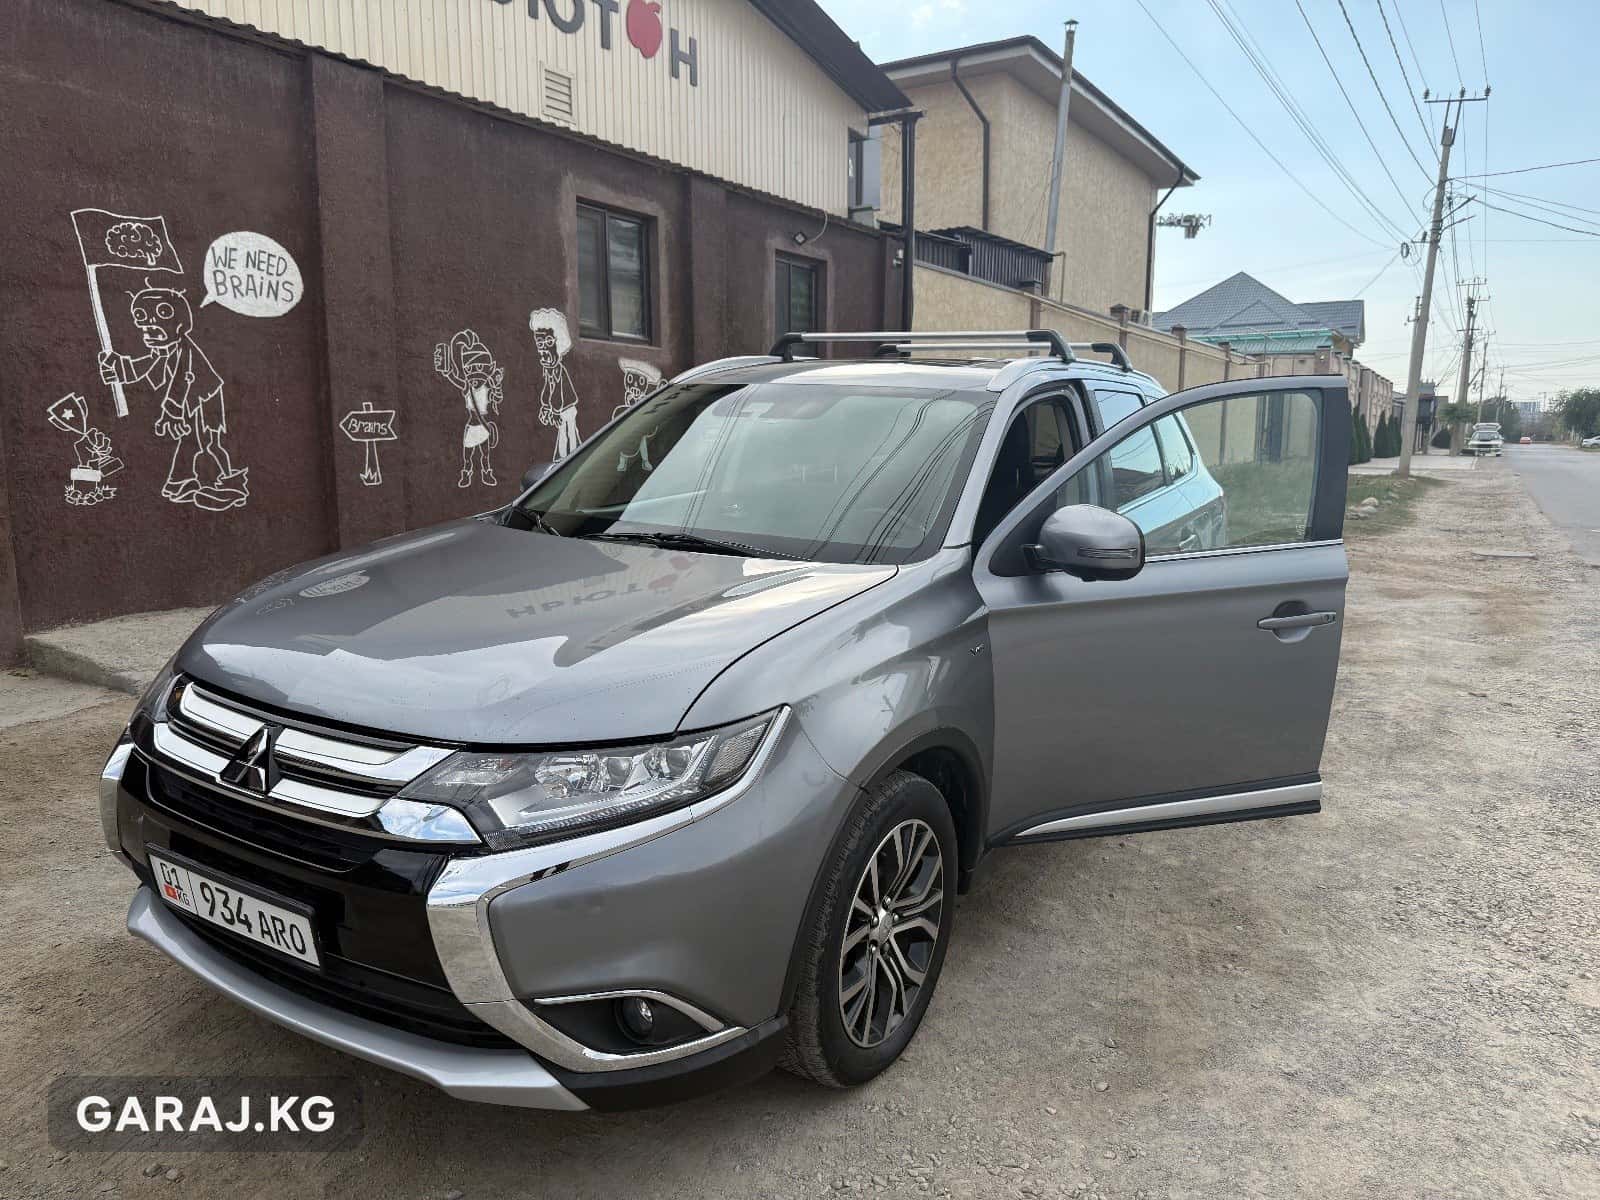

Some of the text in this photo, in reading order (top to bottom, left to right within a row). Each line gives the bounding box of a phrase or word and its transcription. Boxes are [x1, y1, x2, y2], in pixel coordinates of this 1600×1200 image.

[211, 246, 287, 277] WE NEED
[348, 418, 387, 434] Brains
[160, 863, 306, 955] 01 934 ARO
[177, 889, 190, 906] KG
